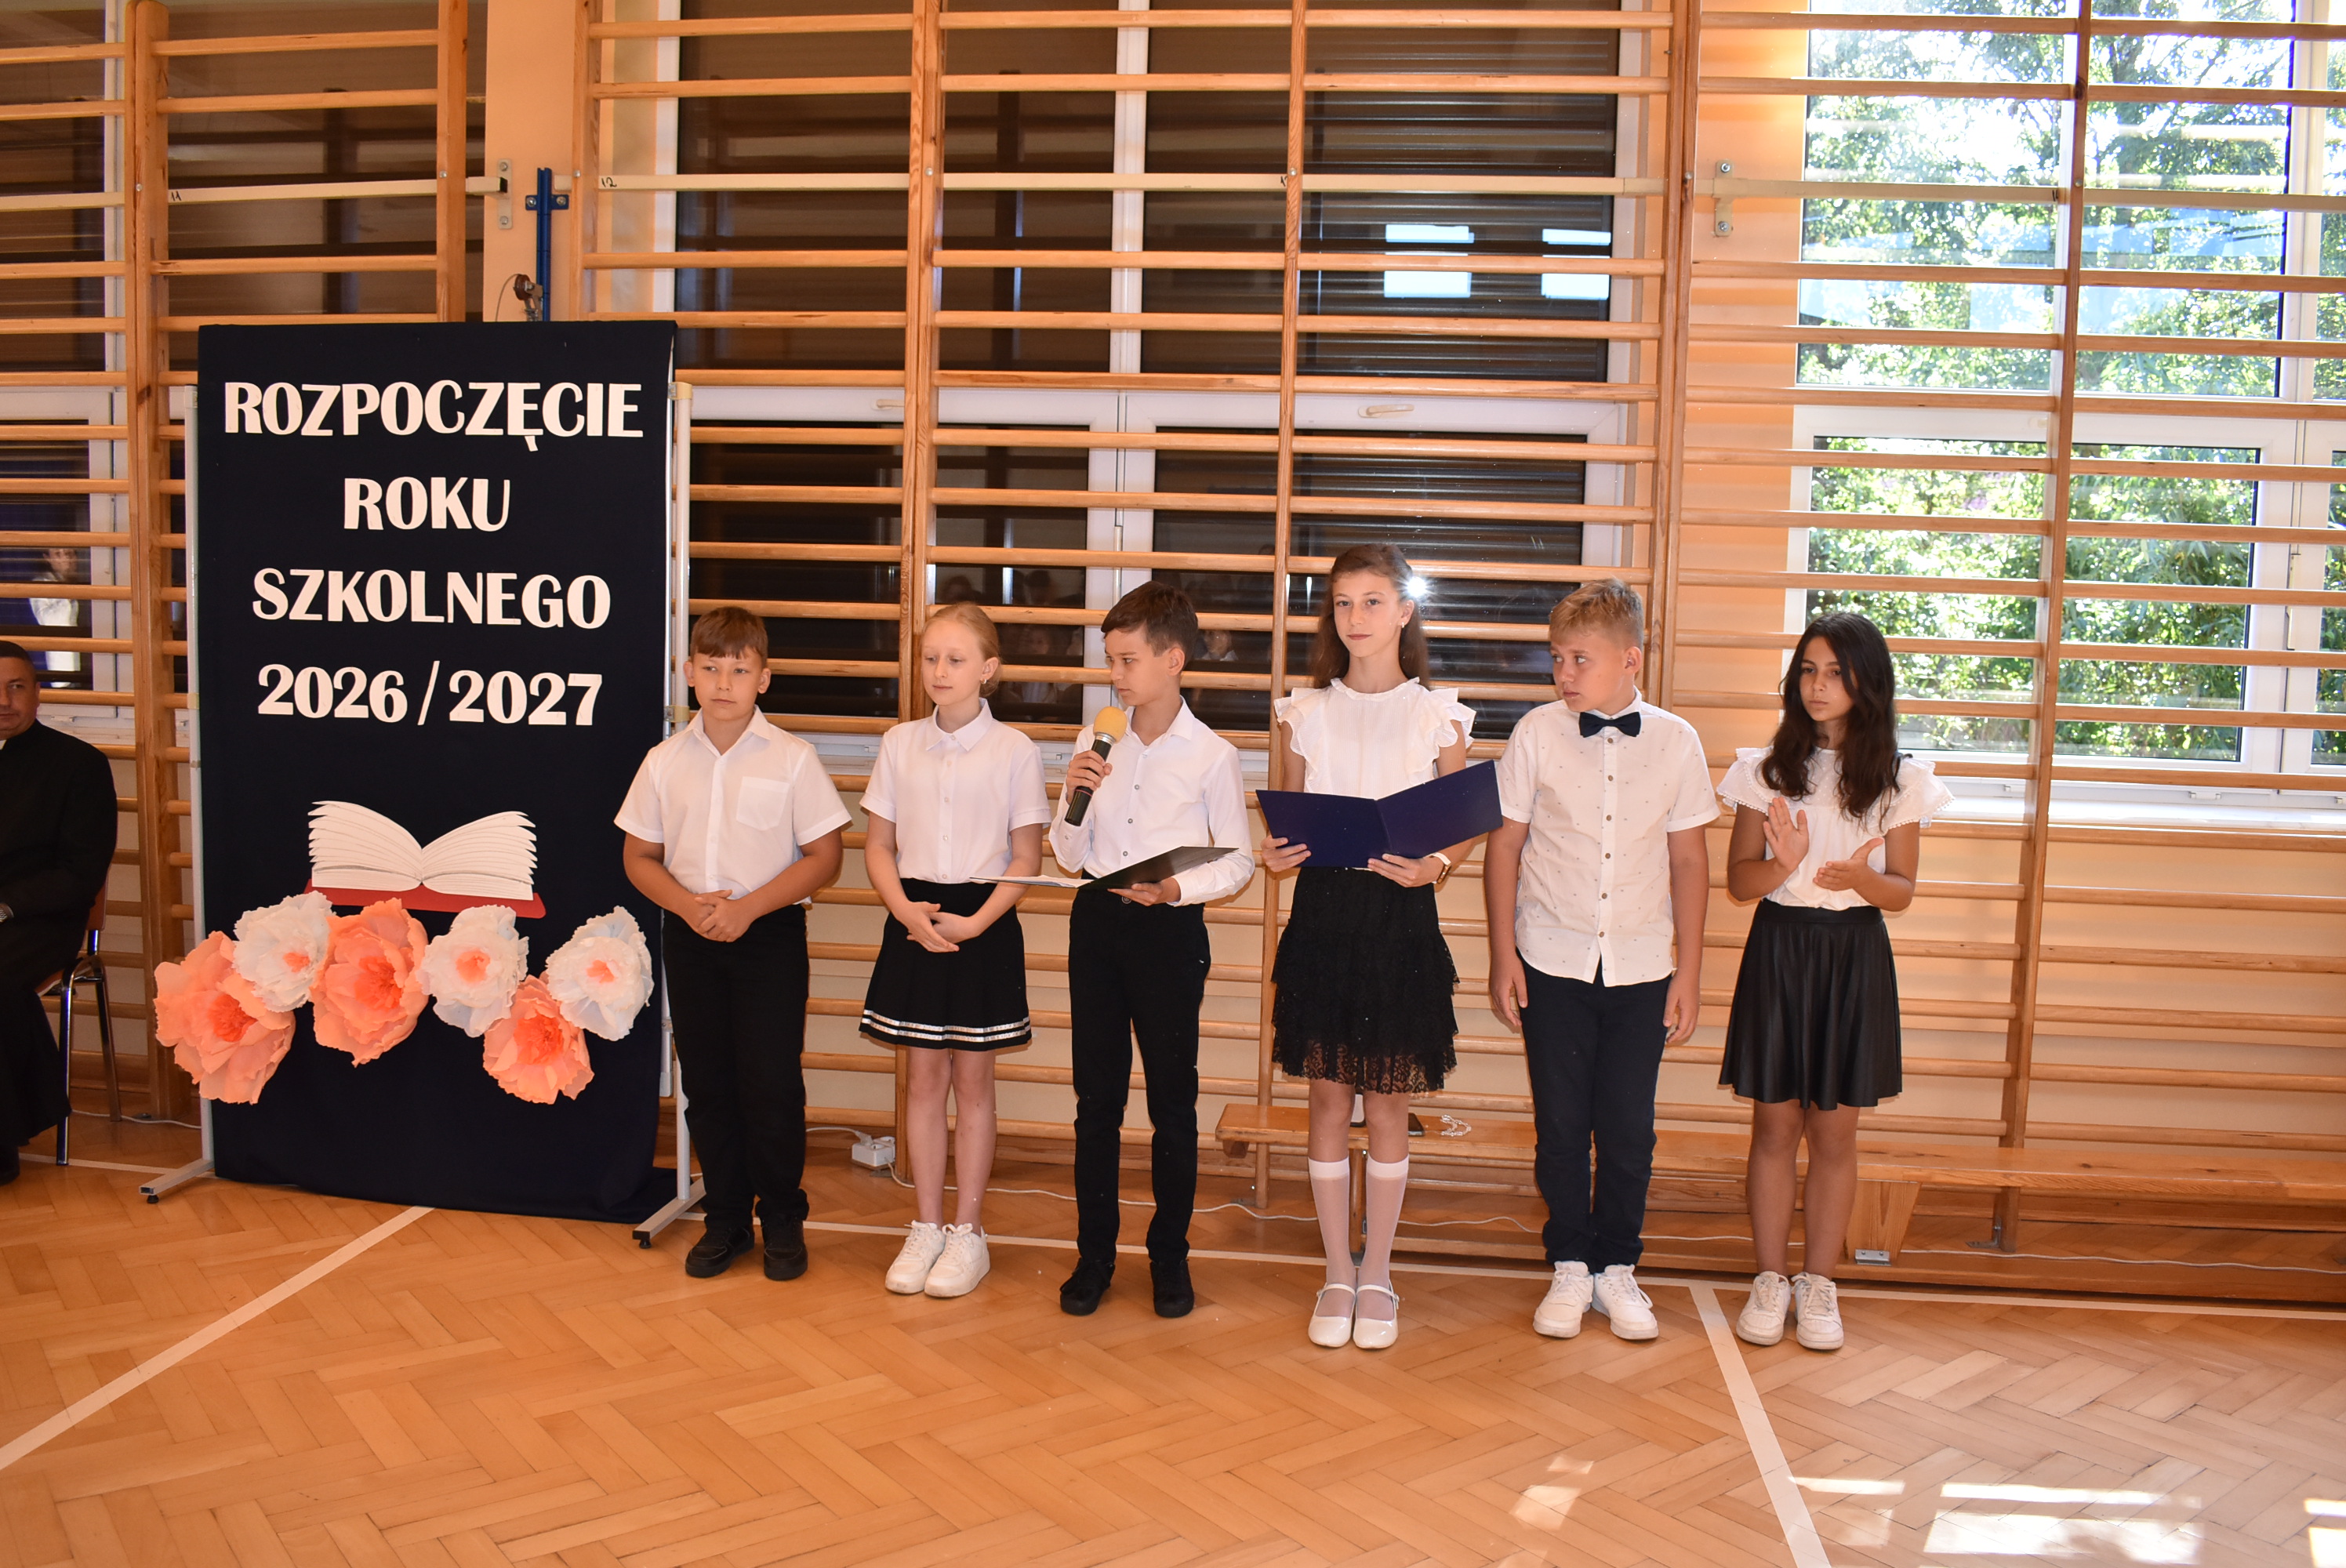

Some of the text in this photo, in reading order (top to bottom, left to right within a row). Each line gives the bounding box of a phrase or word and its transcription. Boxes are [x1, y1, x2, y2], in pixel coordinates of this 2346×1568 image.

[601, 176, 618, 188] 12
[225, 379, 644, 452] ROZPOCZĘCIE
[343, 476, 510, 532] ROKU
[252, 568, 611, 630] SZKOLNEGO
